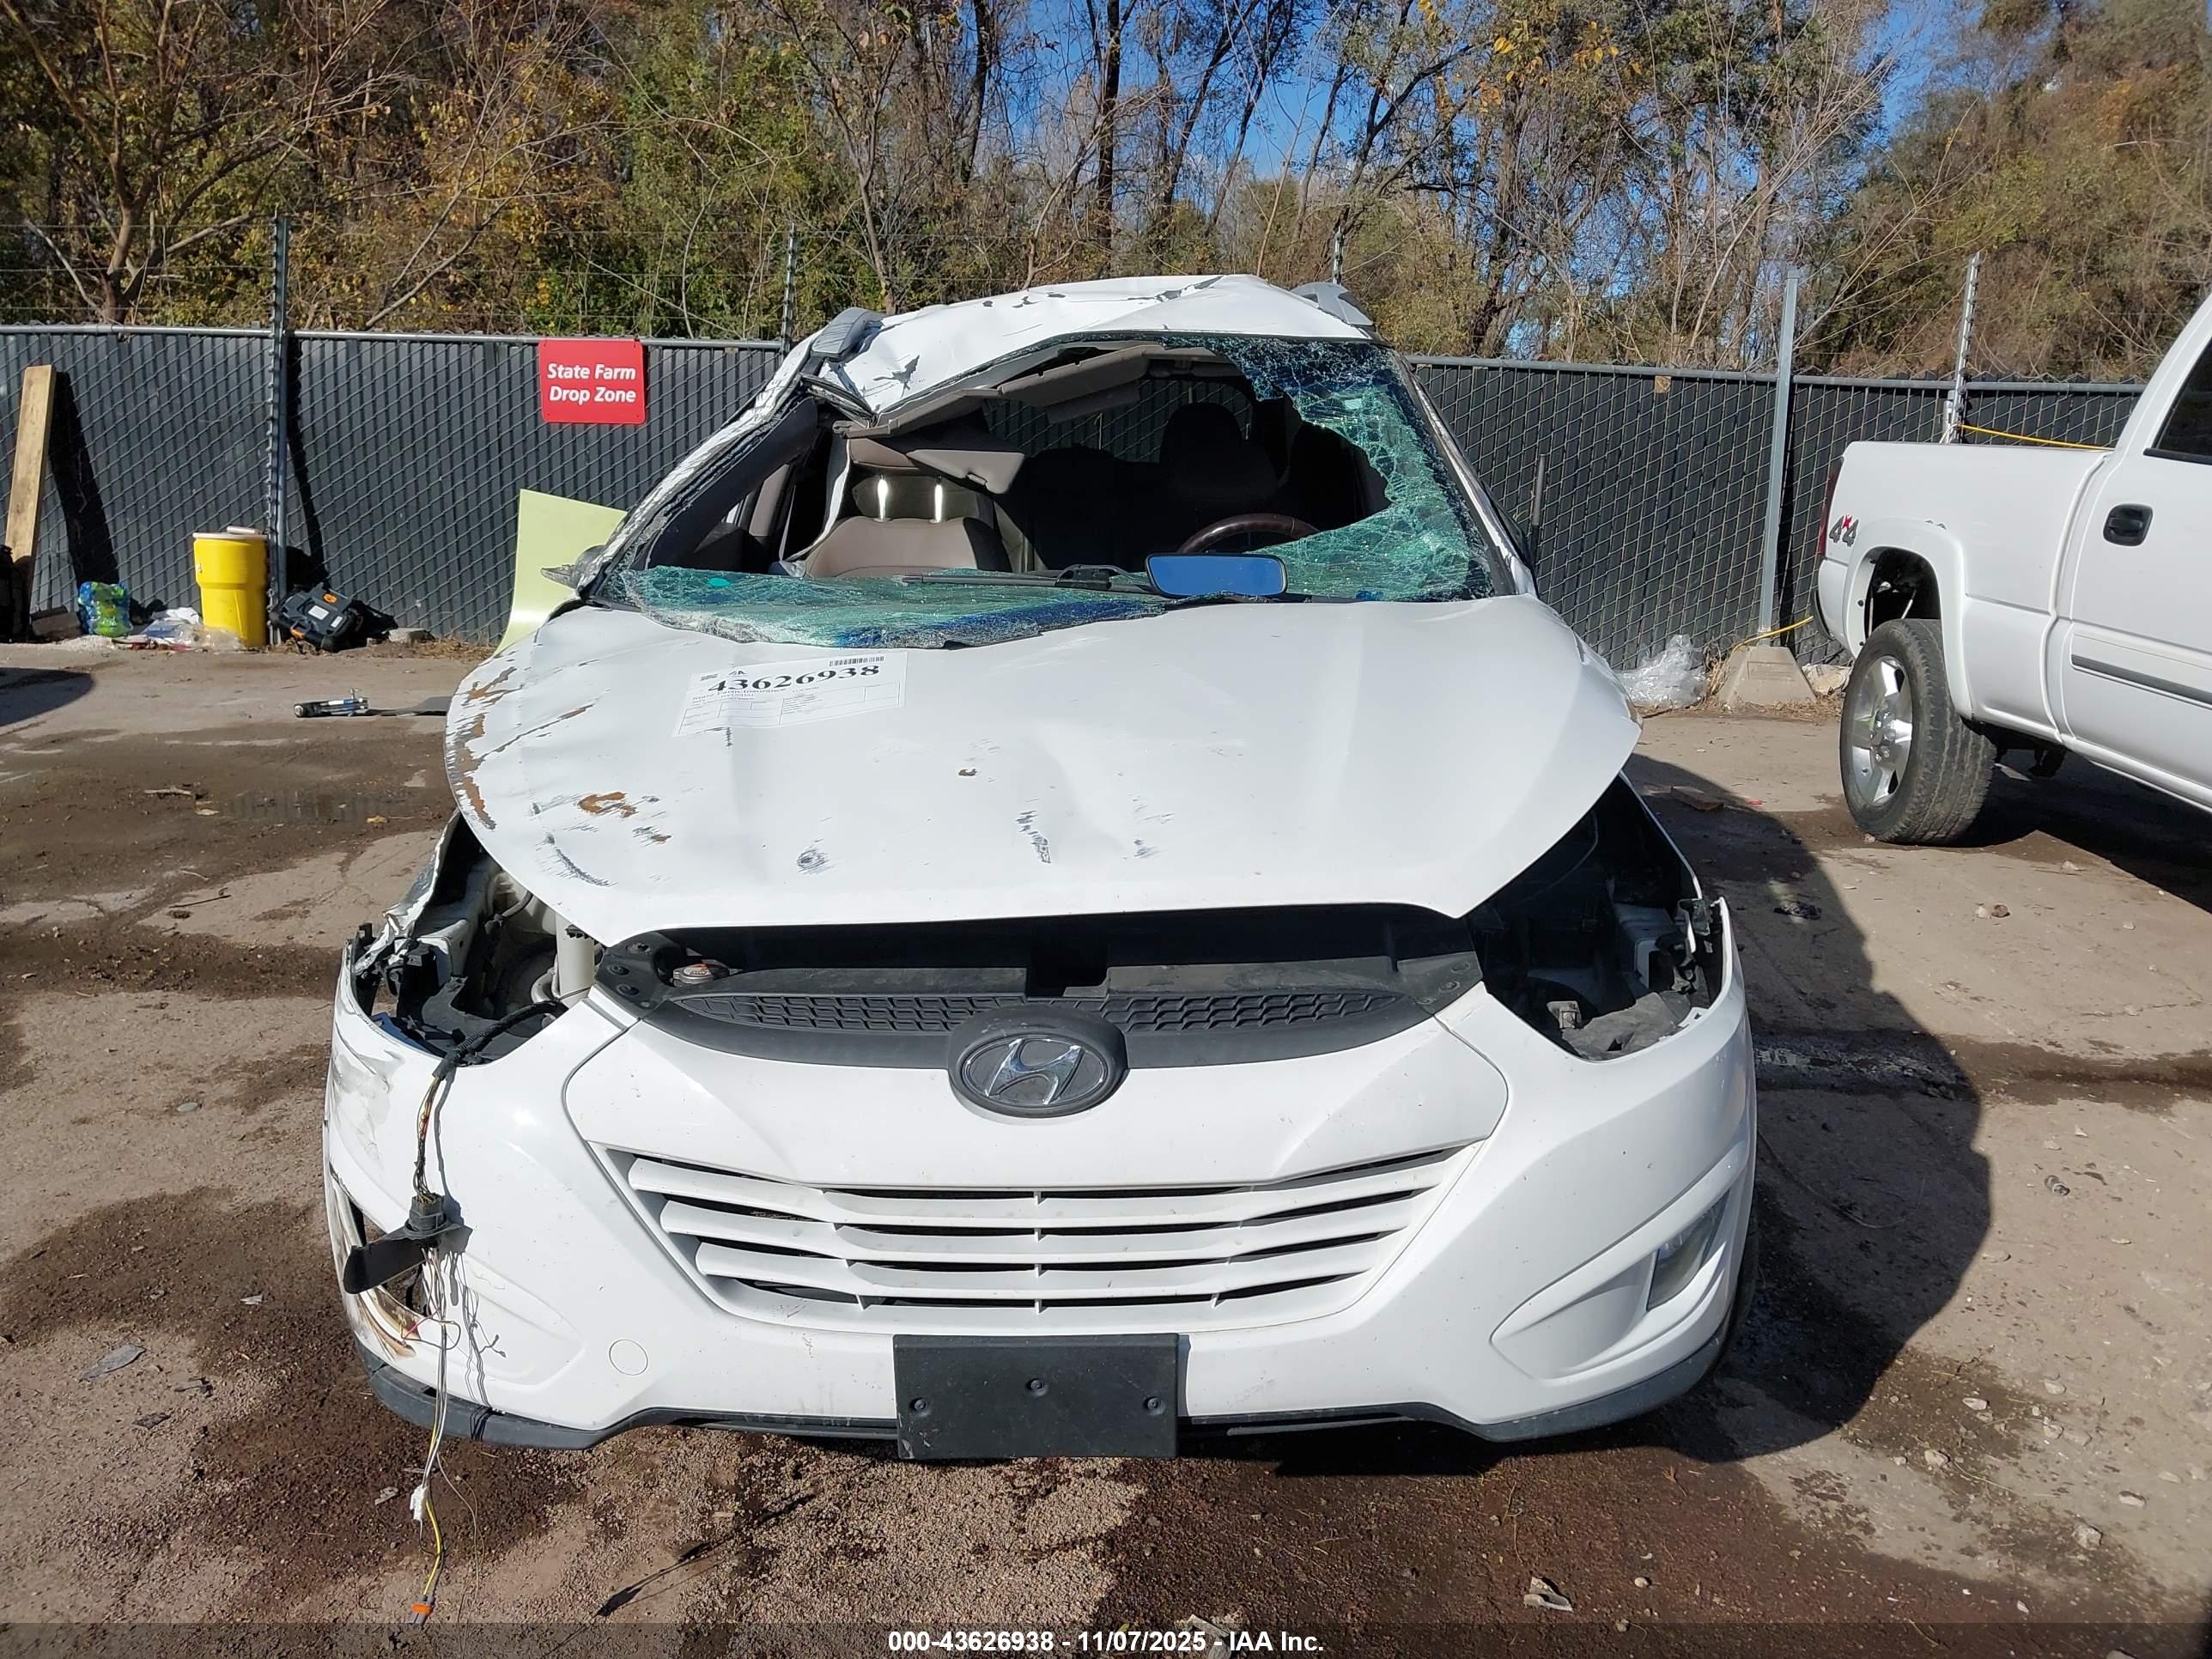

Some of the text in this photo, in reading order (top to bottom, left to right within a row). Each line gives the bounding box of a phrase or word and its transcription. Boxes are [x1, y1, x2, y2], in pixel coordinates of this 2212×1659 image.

[547, 363, 636, 380] State Farm
[550, 386, 636, 405] Drop Zone
[708, 665, 879, 692] 43626938
